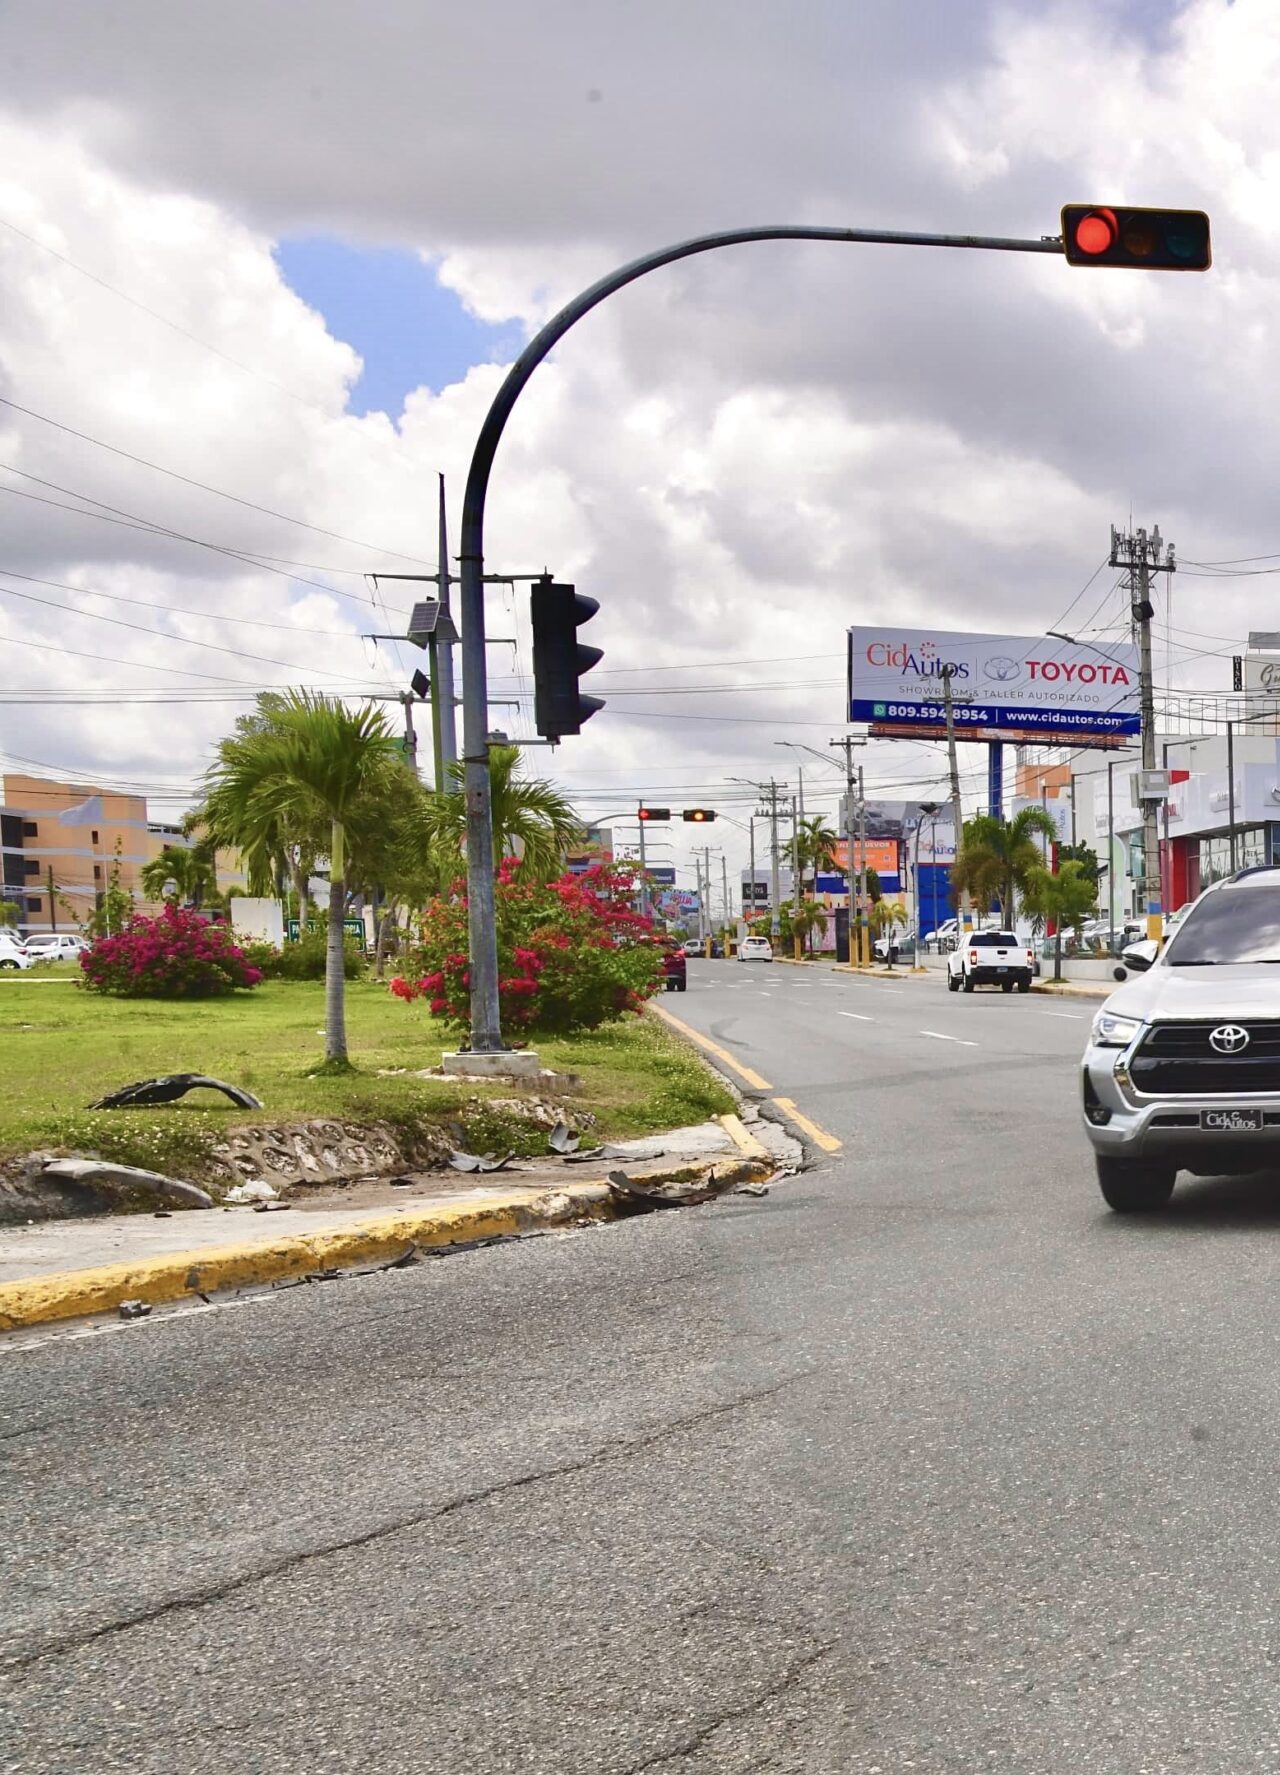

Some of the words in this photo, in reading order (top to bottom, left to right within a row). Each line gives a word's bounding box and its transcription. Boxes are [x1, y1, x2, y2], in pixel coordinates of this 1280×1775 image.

[1025, 660, 1130, 686] TOYOTA
[899, 685, 968, 697] SHOWROM
[984, 690, 1024, 698] TALLER
[1028, 692, 1100, 703] AUTORIZADO
[888, 705, 988, 720] 809.5948954
[1006, 711, 1123, 726] www.cidautos.com
